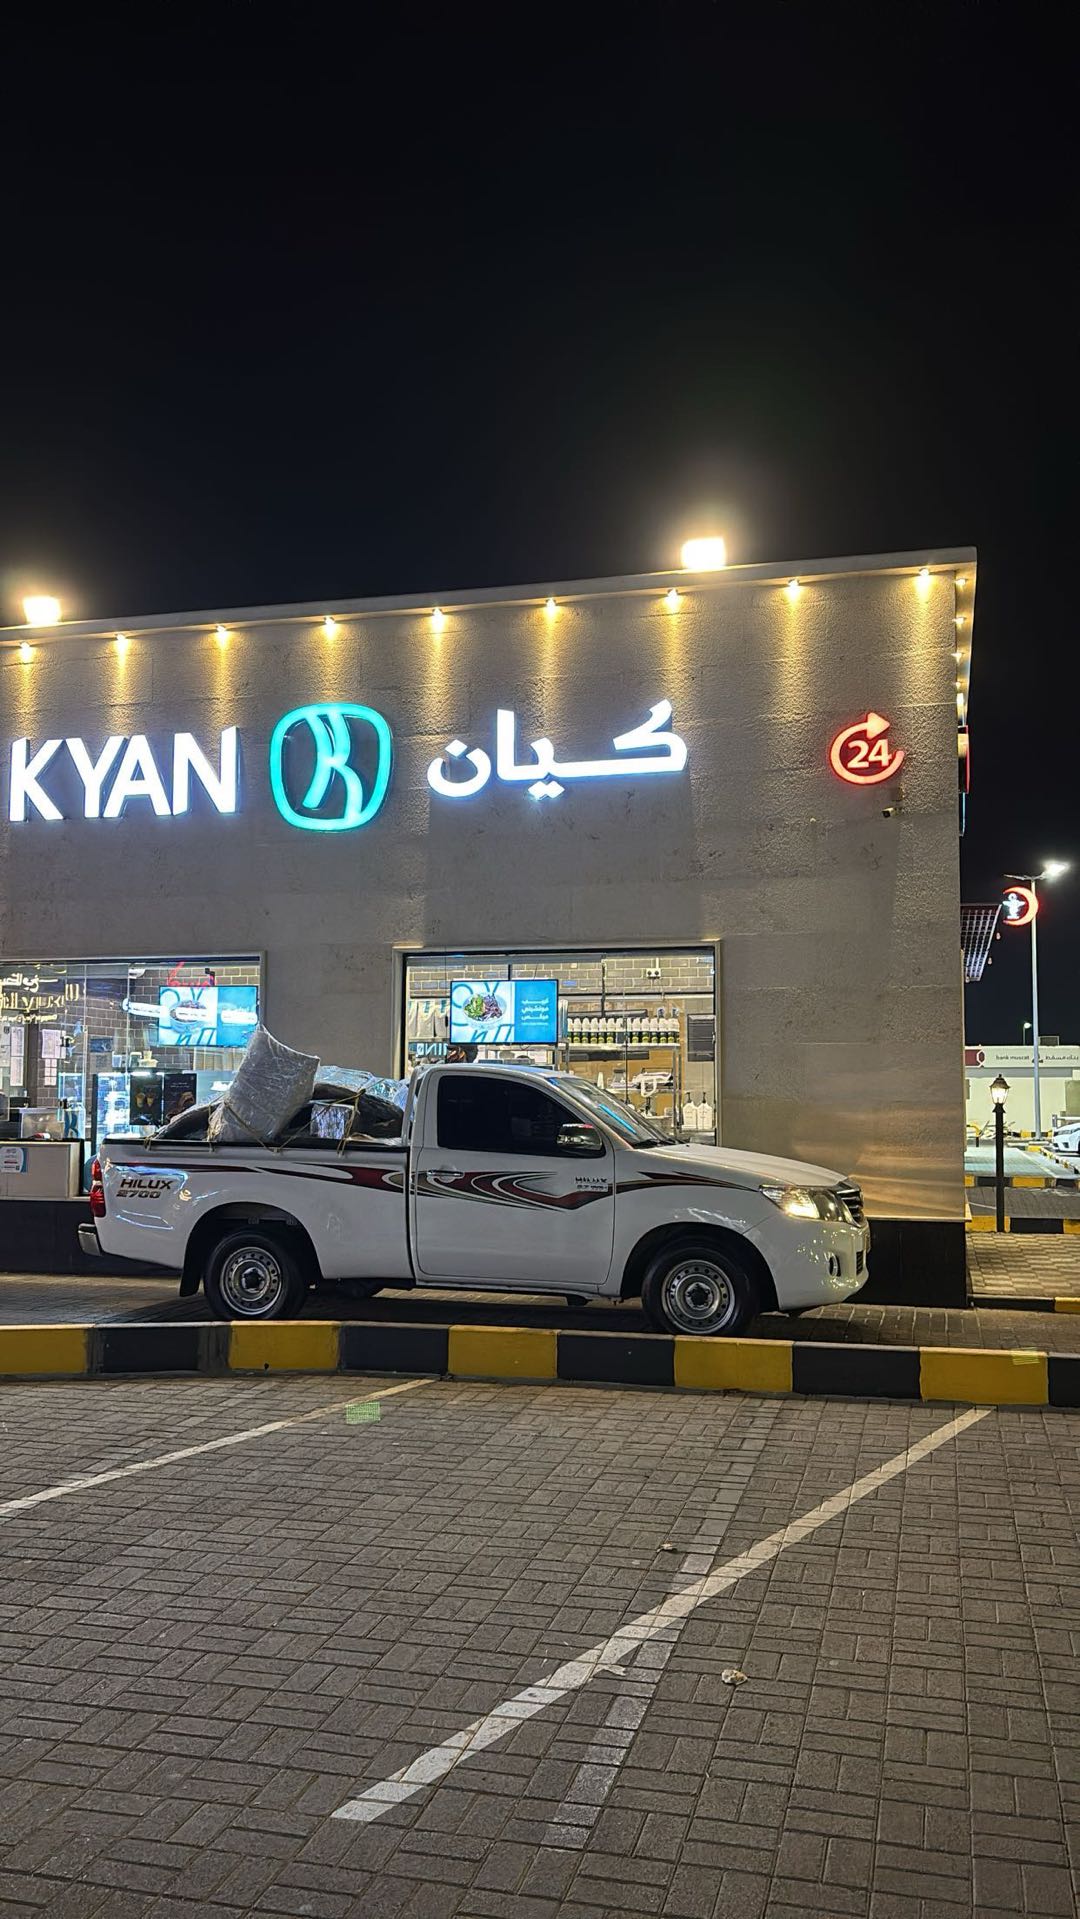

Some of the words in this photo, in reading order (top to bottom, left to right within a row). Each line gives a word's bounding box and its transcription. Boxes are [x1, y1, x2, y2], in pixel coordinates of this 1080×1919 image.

[426, 698, 690, 800] كيان
[847, 739, 892, 769] 24
[9, 725, 240, 822] KYAN
[120, 1178, 174, 1190] HILUX
[575, 1176, 608, 1184] HILUX
[116, 1189, 162, 1199] 2700
